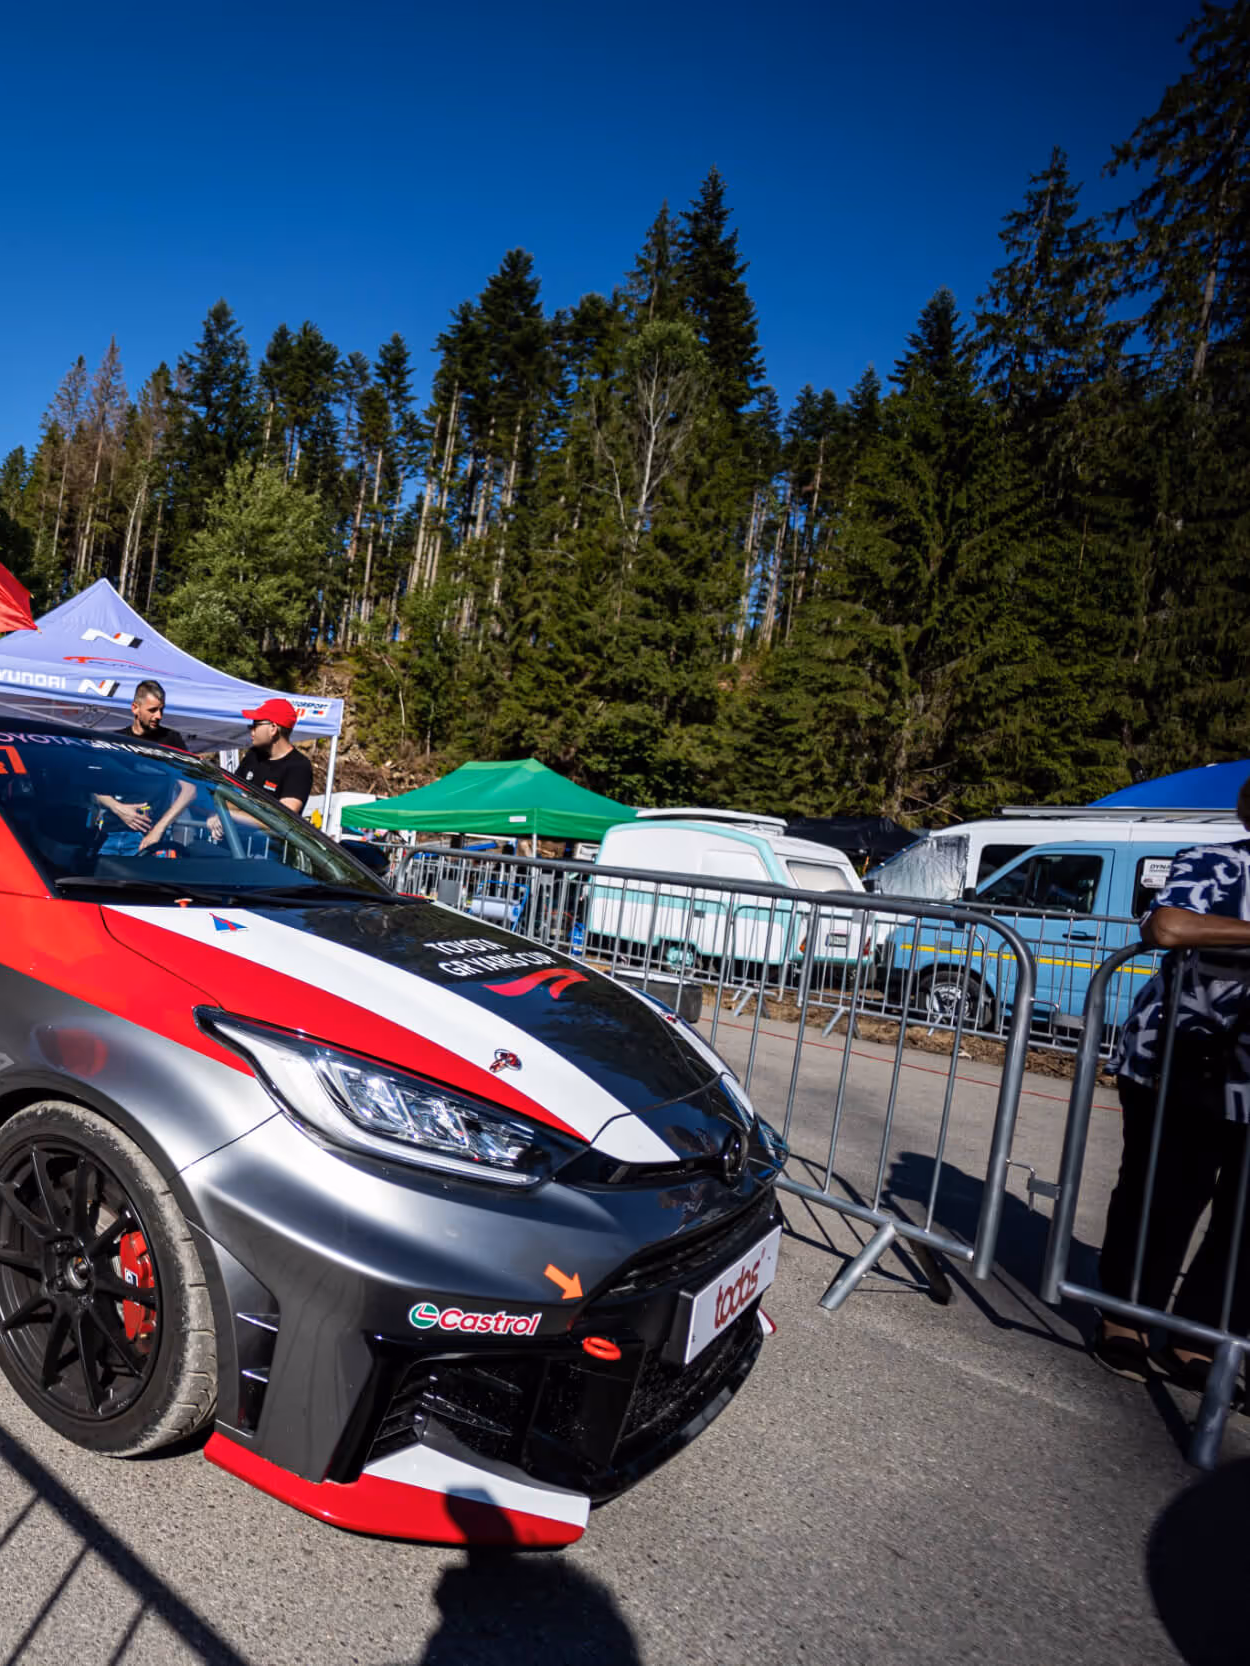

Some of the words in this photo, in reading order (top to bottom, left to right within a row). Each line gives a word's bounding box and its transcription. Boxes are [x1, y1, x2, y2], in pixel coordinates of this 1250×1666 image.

[423, 938, 509, 956] TOYOTA
[438, 961, 485, 977] GR
[463, 953, 530, 972] YARIS
[514, 951, 558, 965] CUP
[713, 1260, 761, 1330] todos
[439, 1307, 542, 1336] Castrol
